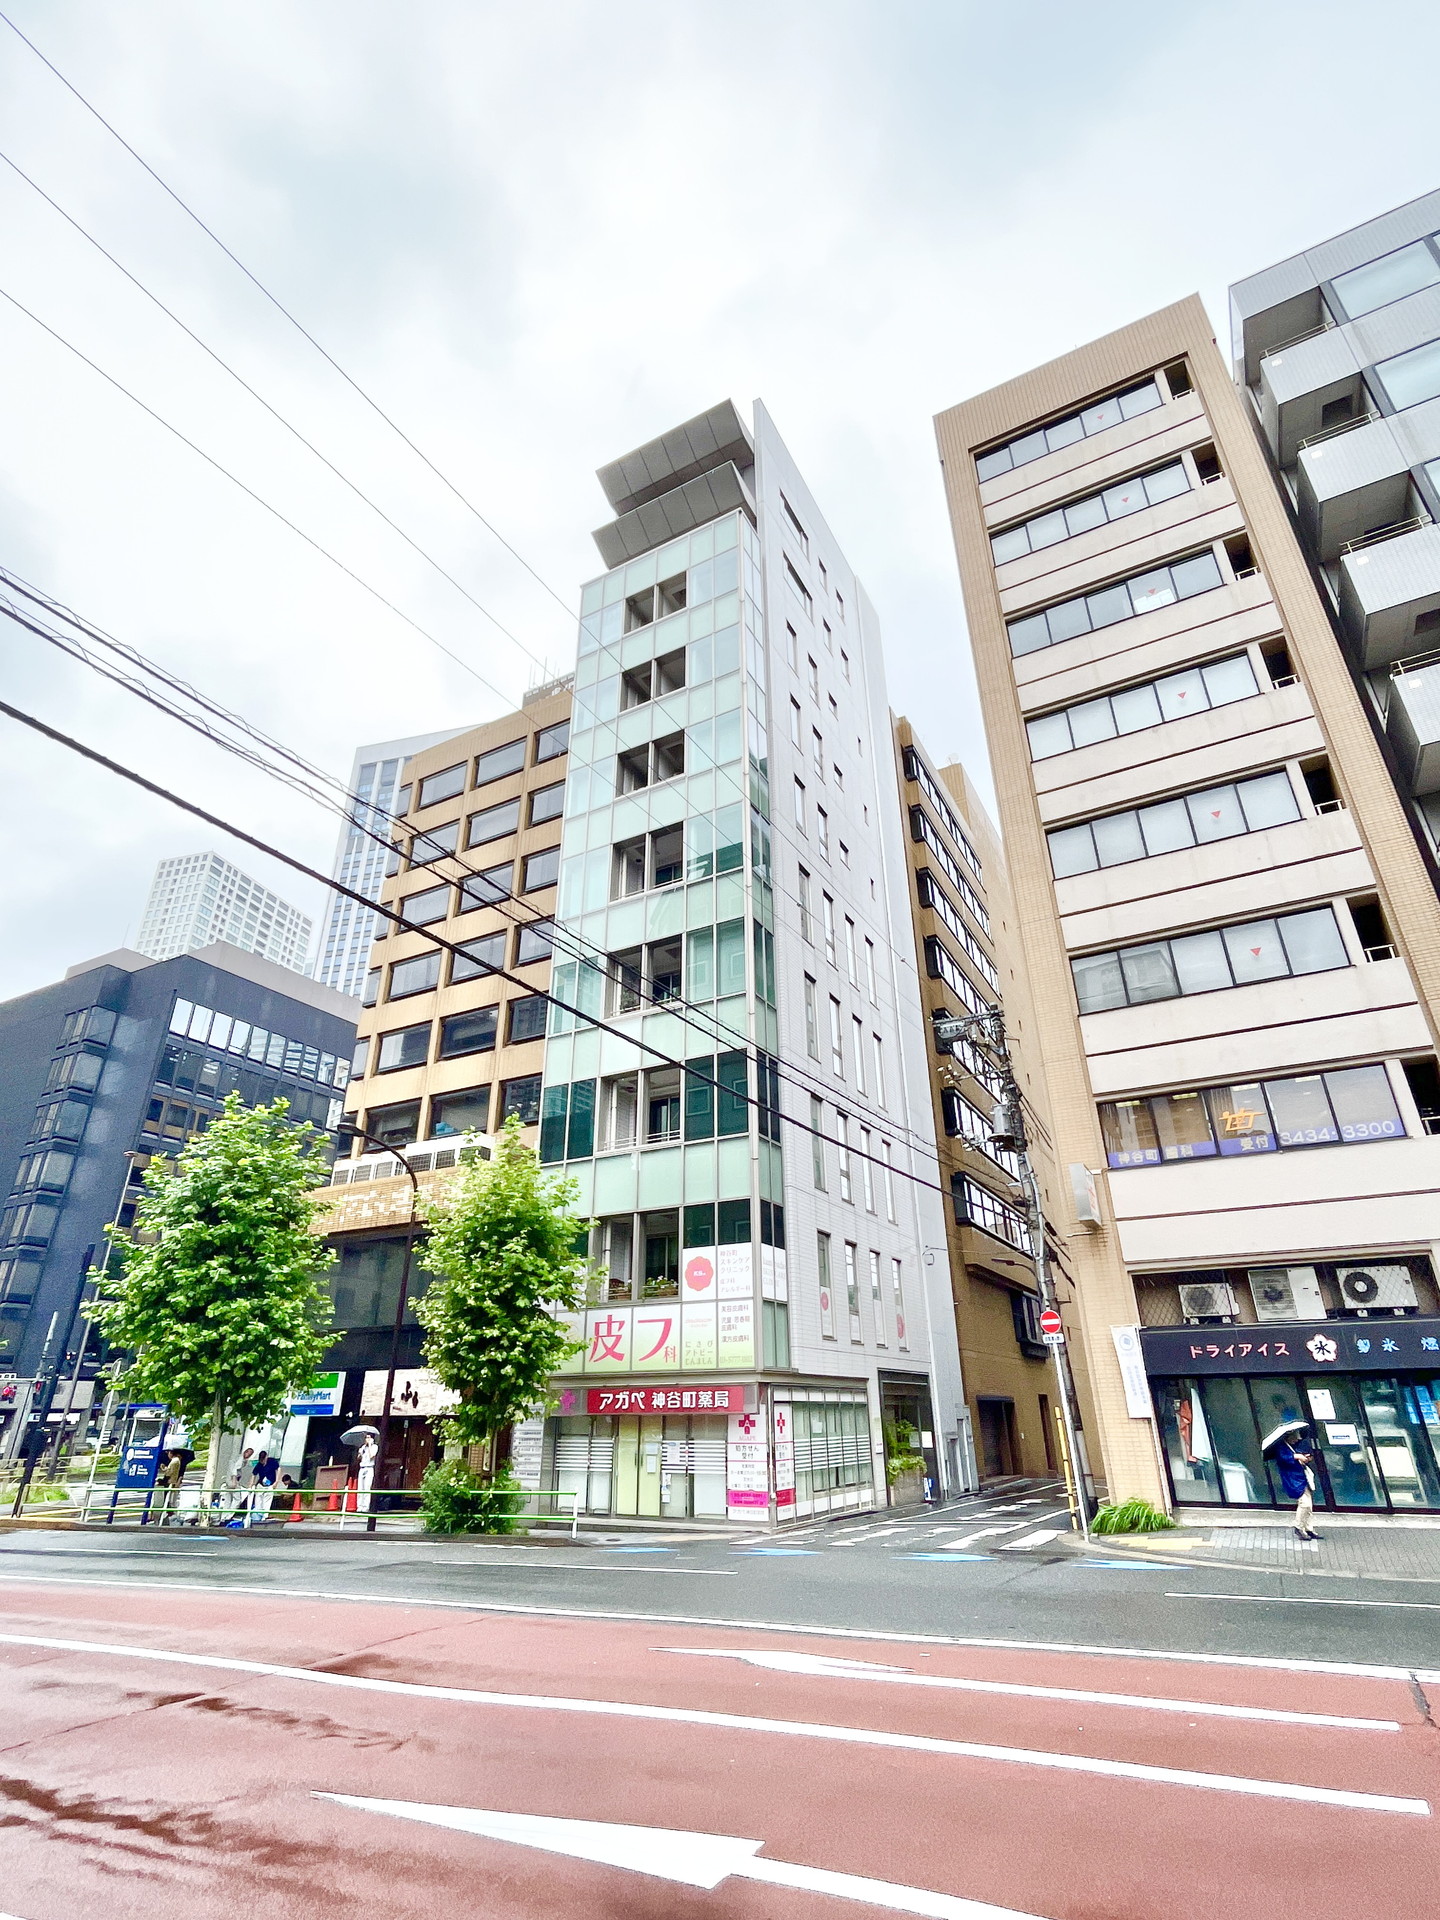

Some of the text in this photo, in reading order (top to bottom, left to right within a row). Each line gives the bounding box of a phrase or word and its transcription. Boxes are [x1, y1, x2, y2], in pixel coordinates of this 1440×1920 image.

[1117, 1149, 1158, 1165] 神谷町
[1189, 1342, 1290, 1359] ドライアイス
[1314, 1340, 1331, 1356] 氷
[599, 1390, 729, 1410] アガペ 神谷町薬局
